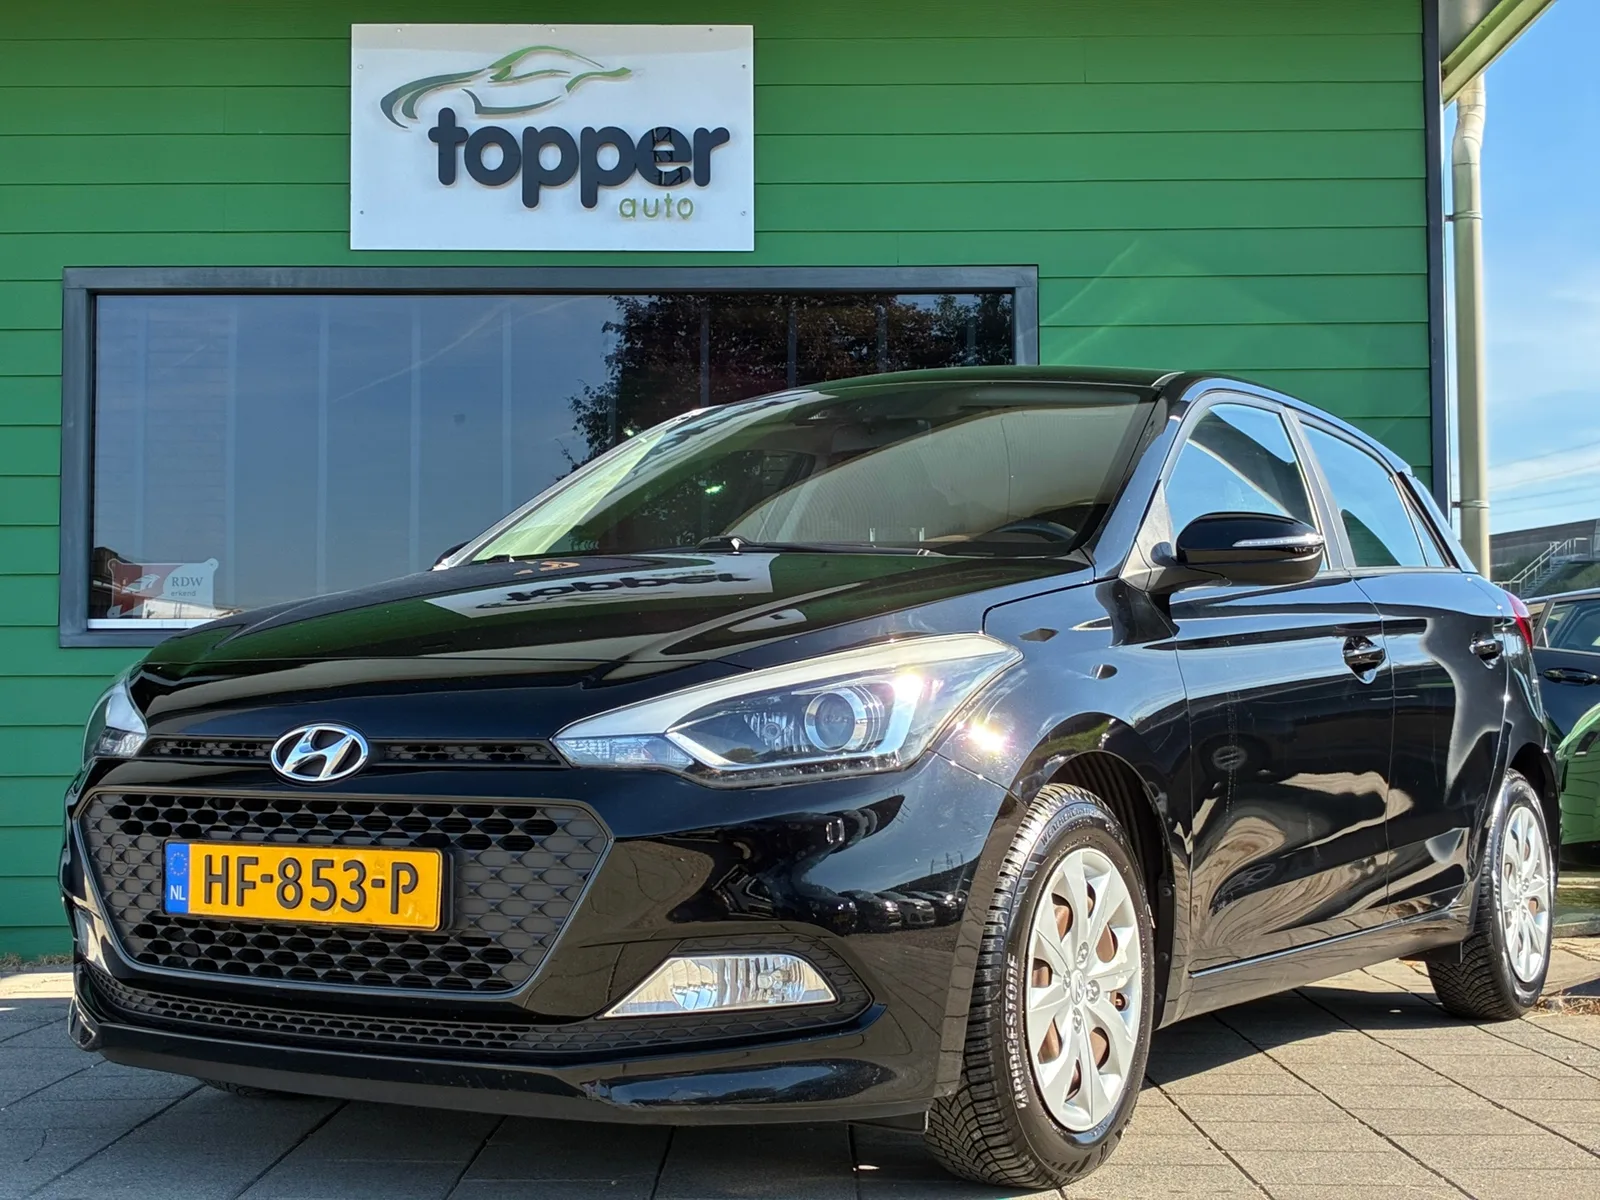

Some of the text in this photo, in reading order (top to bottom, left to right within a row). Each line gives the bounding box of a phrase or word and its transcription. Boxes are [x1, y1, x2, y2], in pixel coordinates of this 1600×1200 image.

[427, 107, 730, 208] topper
[619, 193, 694, 220] auto
[171, 576, 203, 587] RDW
[169, 884, 186, 901] NL
[204, 854, 419, 914] HF-853-P
[1005, 953, 1030, 1109] BRIDGESTONE
